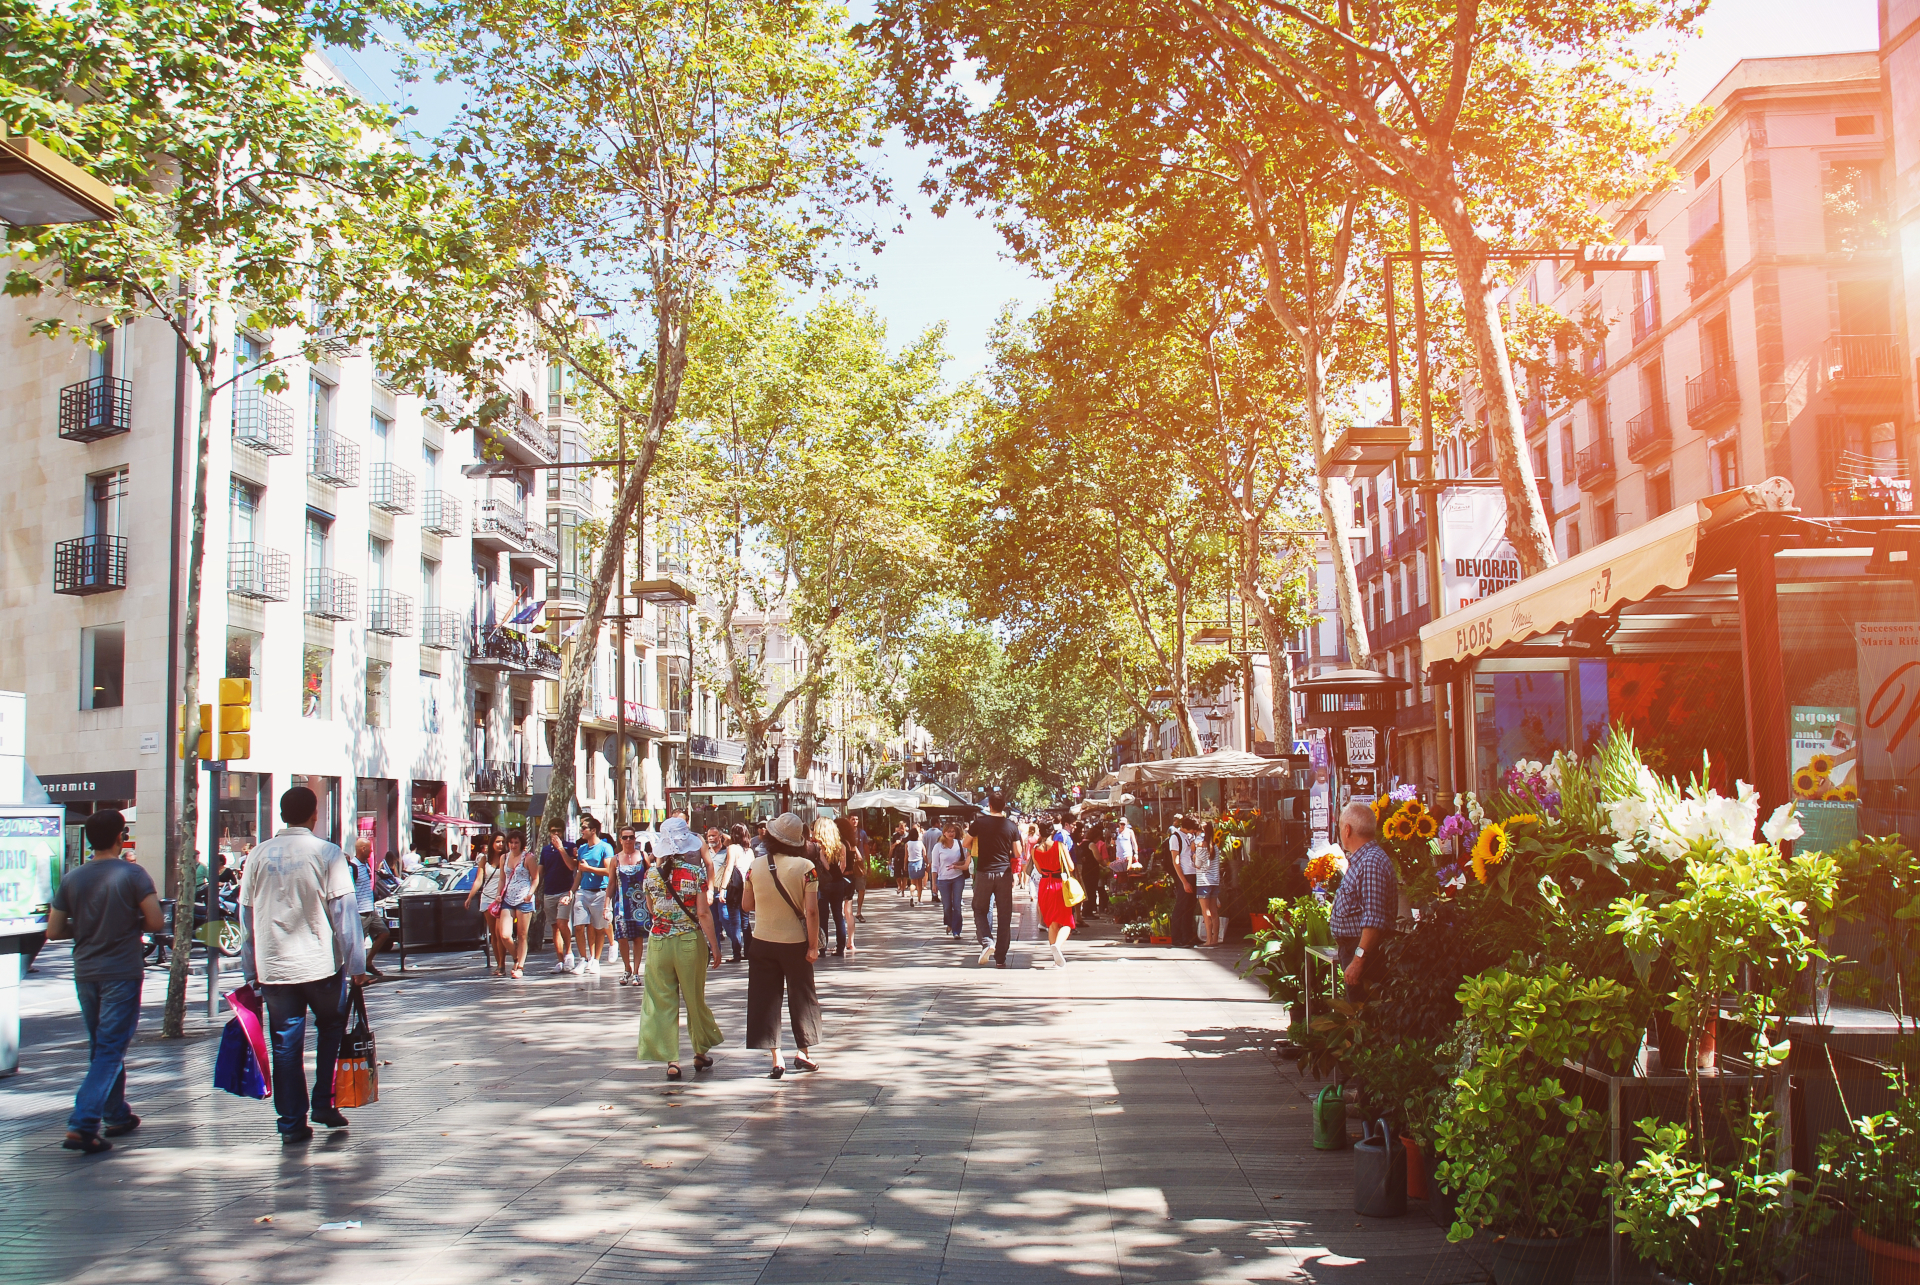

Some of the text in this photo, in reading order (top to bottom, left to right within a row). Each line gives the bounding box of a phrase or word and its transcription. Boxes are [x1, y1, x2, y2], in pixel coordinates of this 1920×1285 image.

[1456, 558, 1518, 579] DEVORAR
[1860, 623, 1914, 633] Successors
[1456, 617, 1493, 655] FLORS
[1861, 636, 1919, 647] Maria Rifé
[1795, 712, 1841, 725] agost
[1795, 730, 1822, 739] amb
[1349, 736, 1373, 749] Beatles
[1795, 740, 1826, 749] flors
